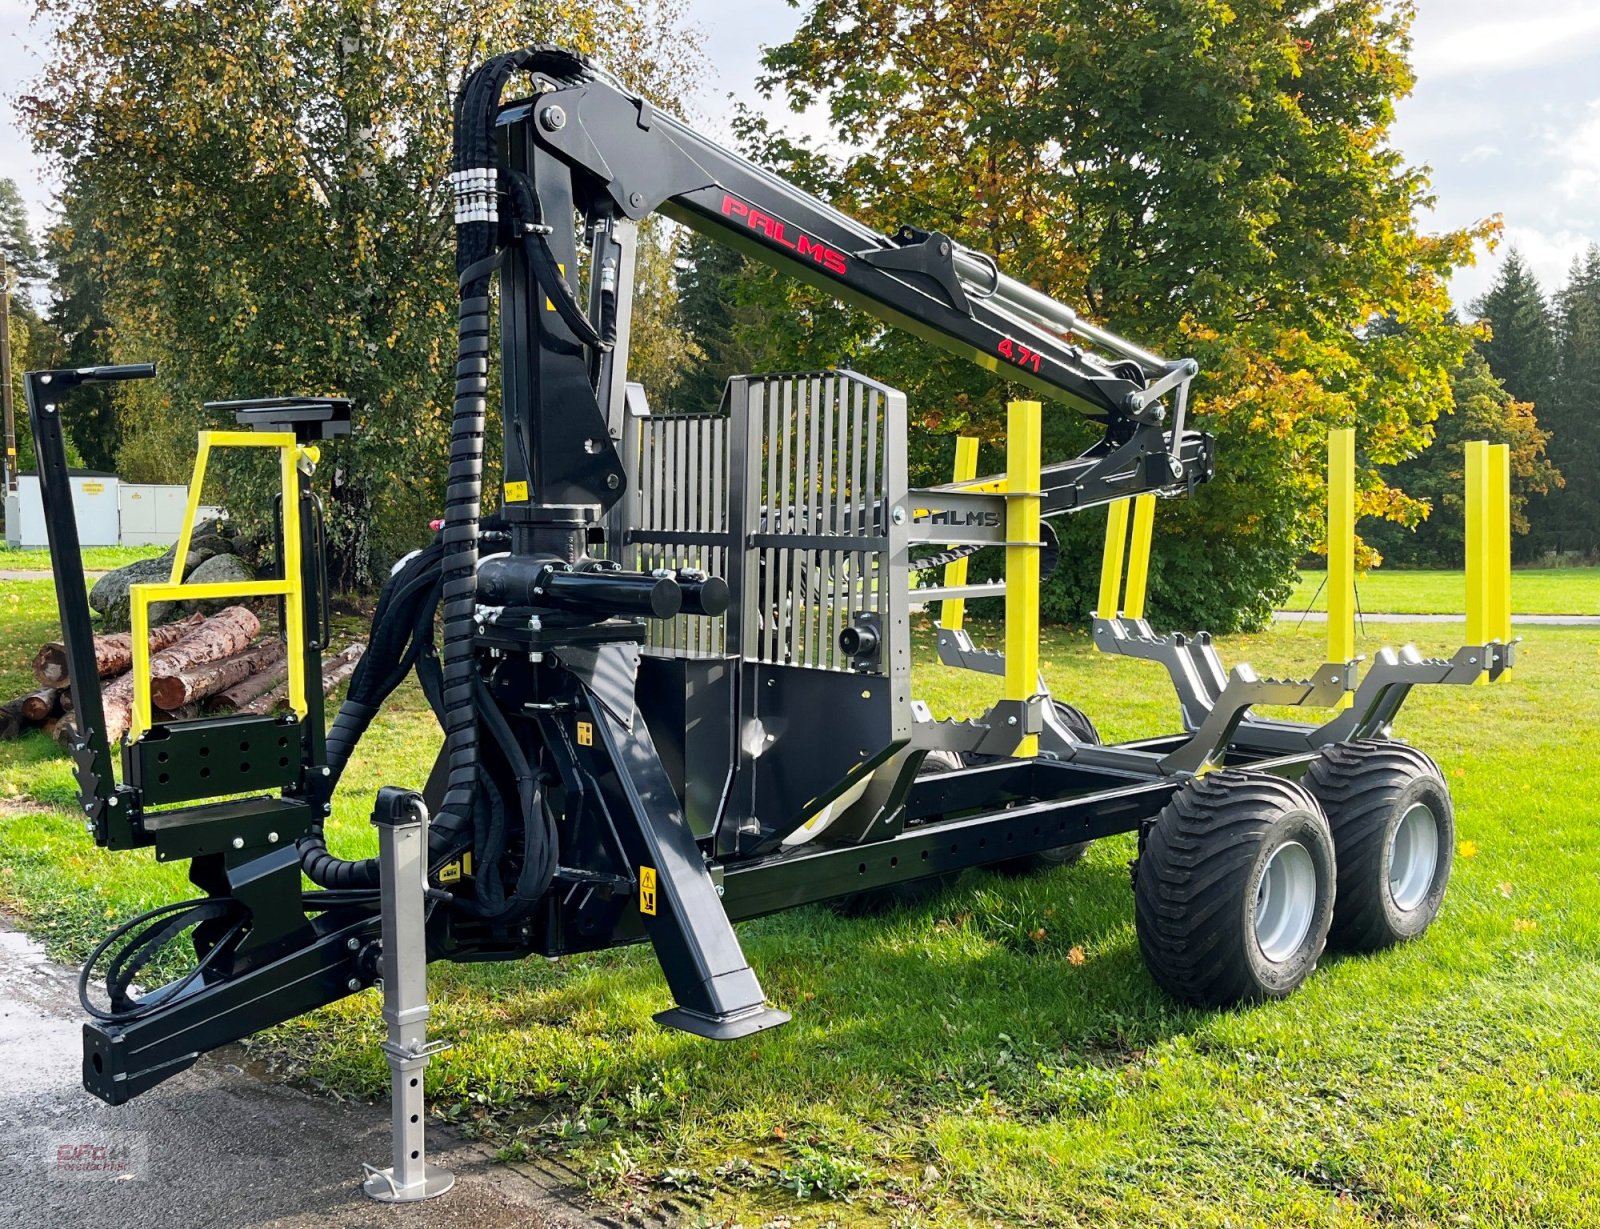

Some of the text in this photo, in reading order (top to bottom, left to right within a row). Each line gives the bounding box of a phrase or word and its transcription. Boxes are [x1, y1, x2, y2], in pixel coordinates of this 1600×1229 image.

[721, 194, 848, 276] PALMS
[997, 338, 1041, 374] 4.71
[912, 508, 1001, 528] PALMS
